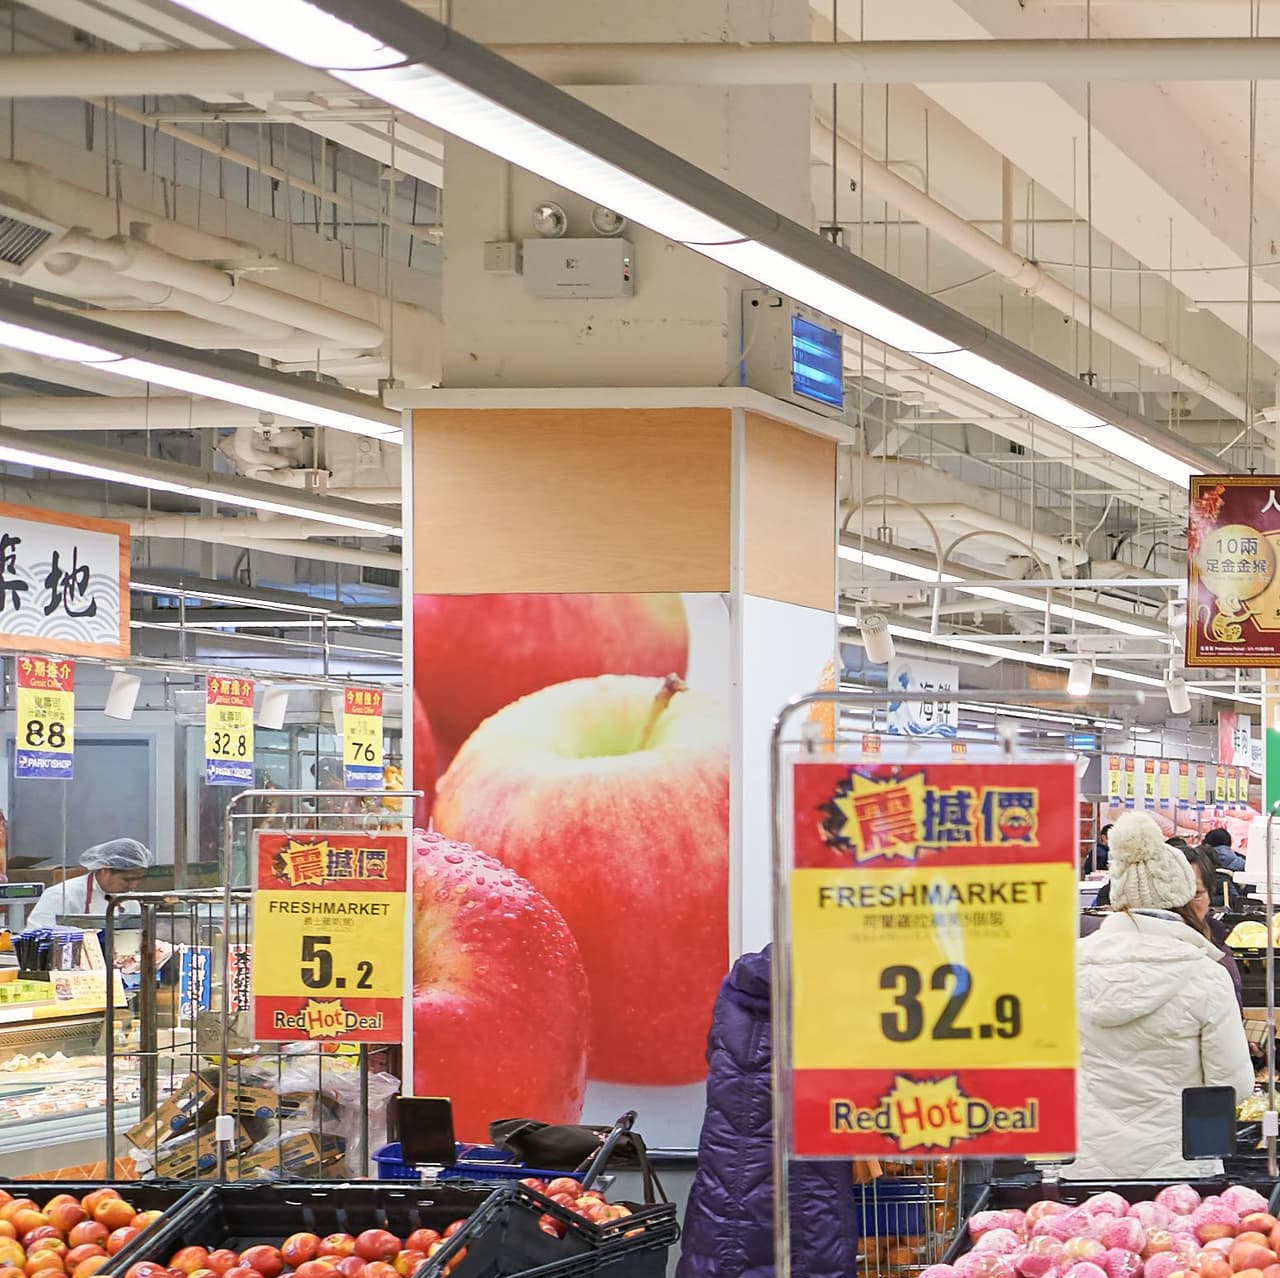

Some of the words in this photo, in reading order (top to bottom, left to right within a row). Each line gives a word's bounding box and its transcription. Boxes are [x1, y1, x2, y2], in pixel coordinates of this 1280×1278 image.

[26, 720, 66, 748] 88
[212, 732, 247, 758] 32.8
[352, 743, 376, 762] 76
[269, 901, 390, 916] FRESHMARKET
[819, 881, 1048, 909] FRESHMARKET
[300, 935, 374, 989] 5.2
[879, 963, 1022, 1043] 32.9
[274, 1012, 306, 1029] Red
[307, 1009, 343, 1030] Hot
[344, 1012, 382, 1028] Deal
[832, 1102, 891, 1131] Red
[898, 1095, 963, 1134] Hot
[966, 1102, 1036, 1130] Deal
